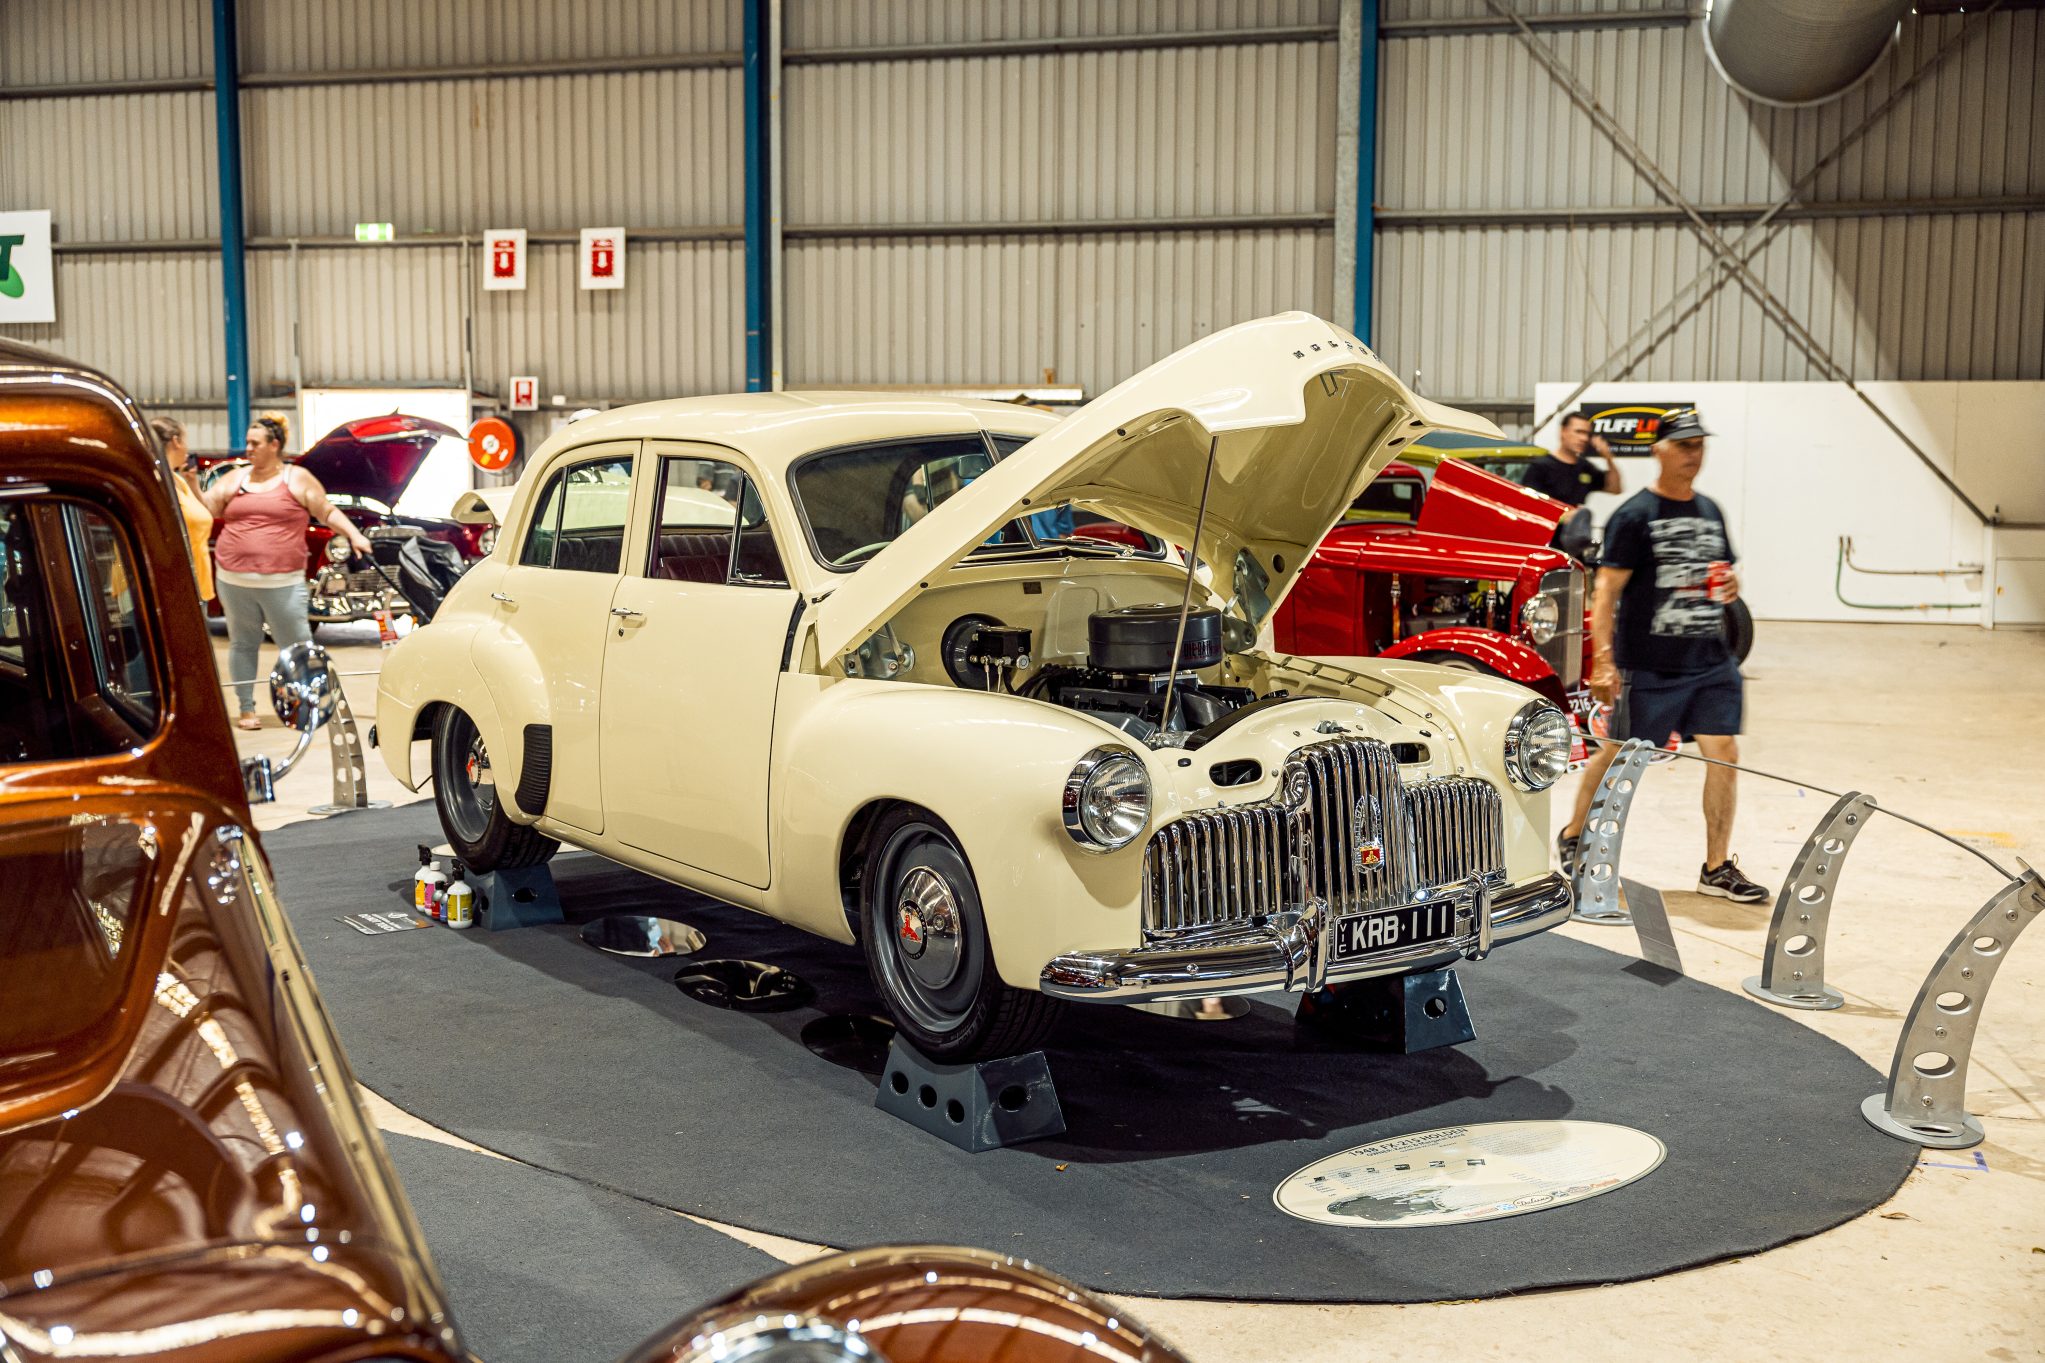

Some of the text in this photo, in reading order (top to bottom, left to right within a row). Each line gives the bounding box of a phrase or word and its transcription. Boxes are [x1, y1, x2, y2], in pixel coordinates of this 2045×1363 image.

[1338, 922, 1347, 954] VIC
[1352, 915, 1399, 951] KRB
[1419, 1127, 1469, 1140] HOLDEN
